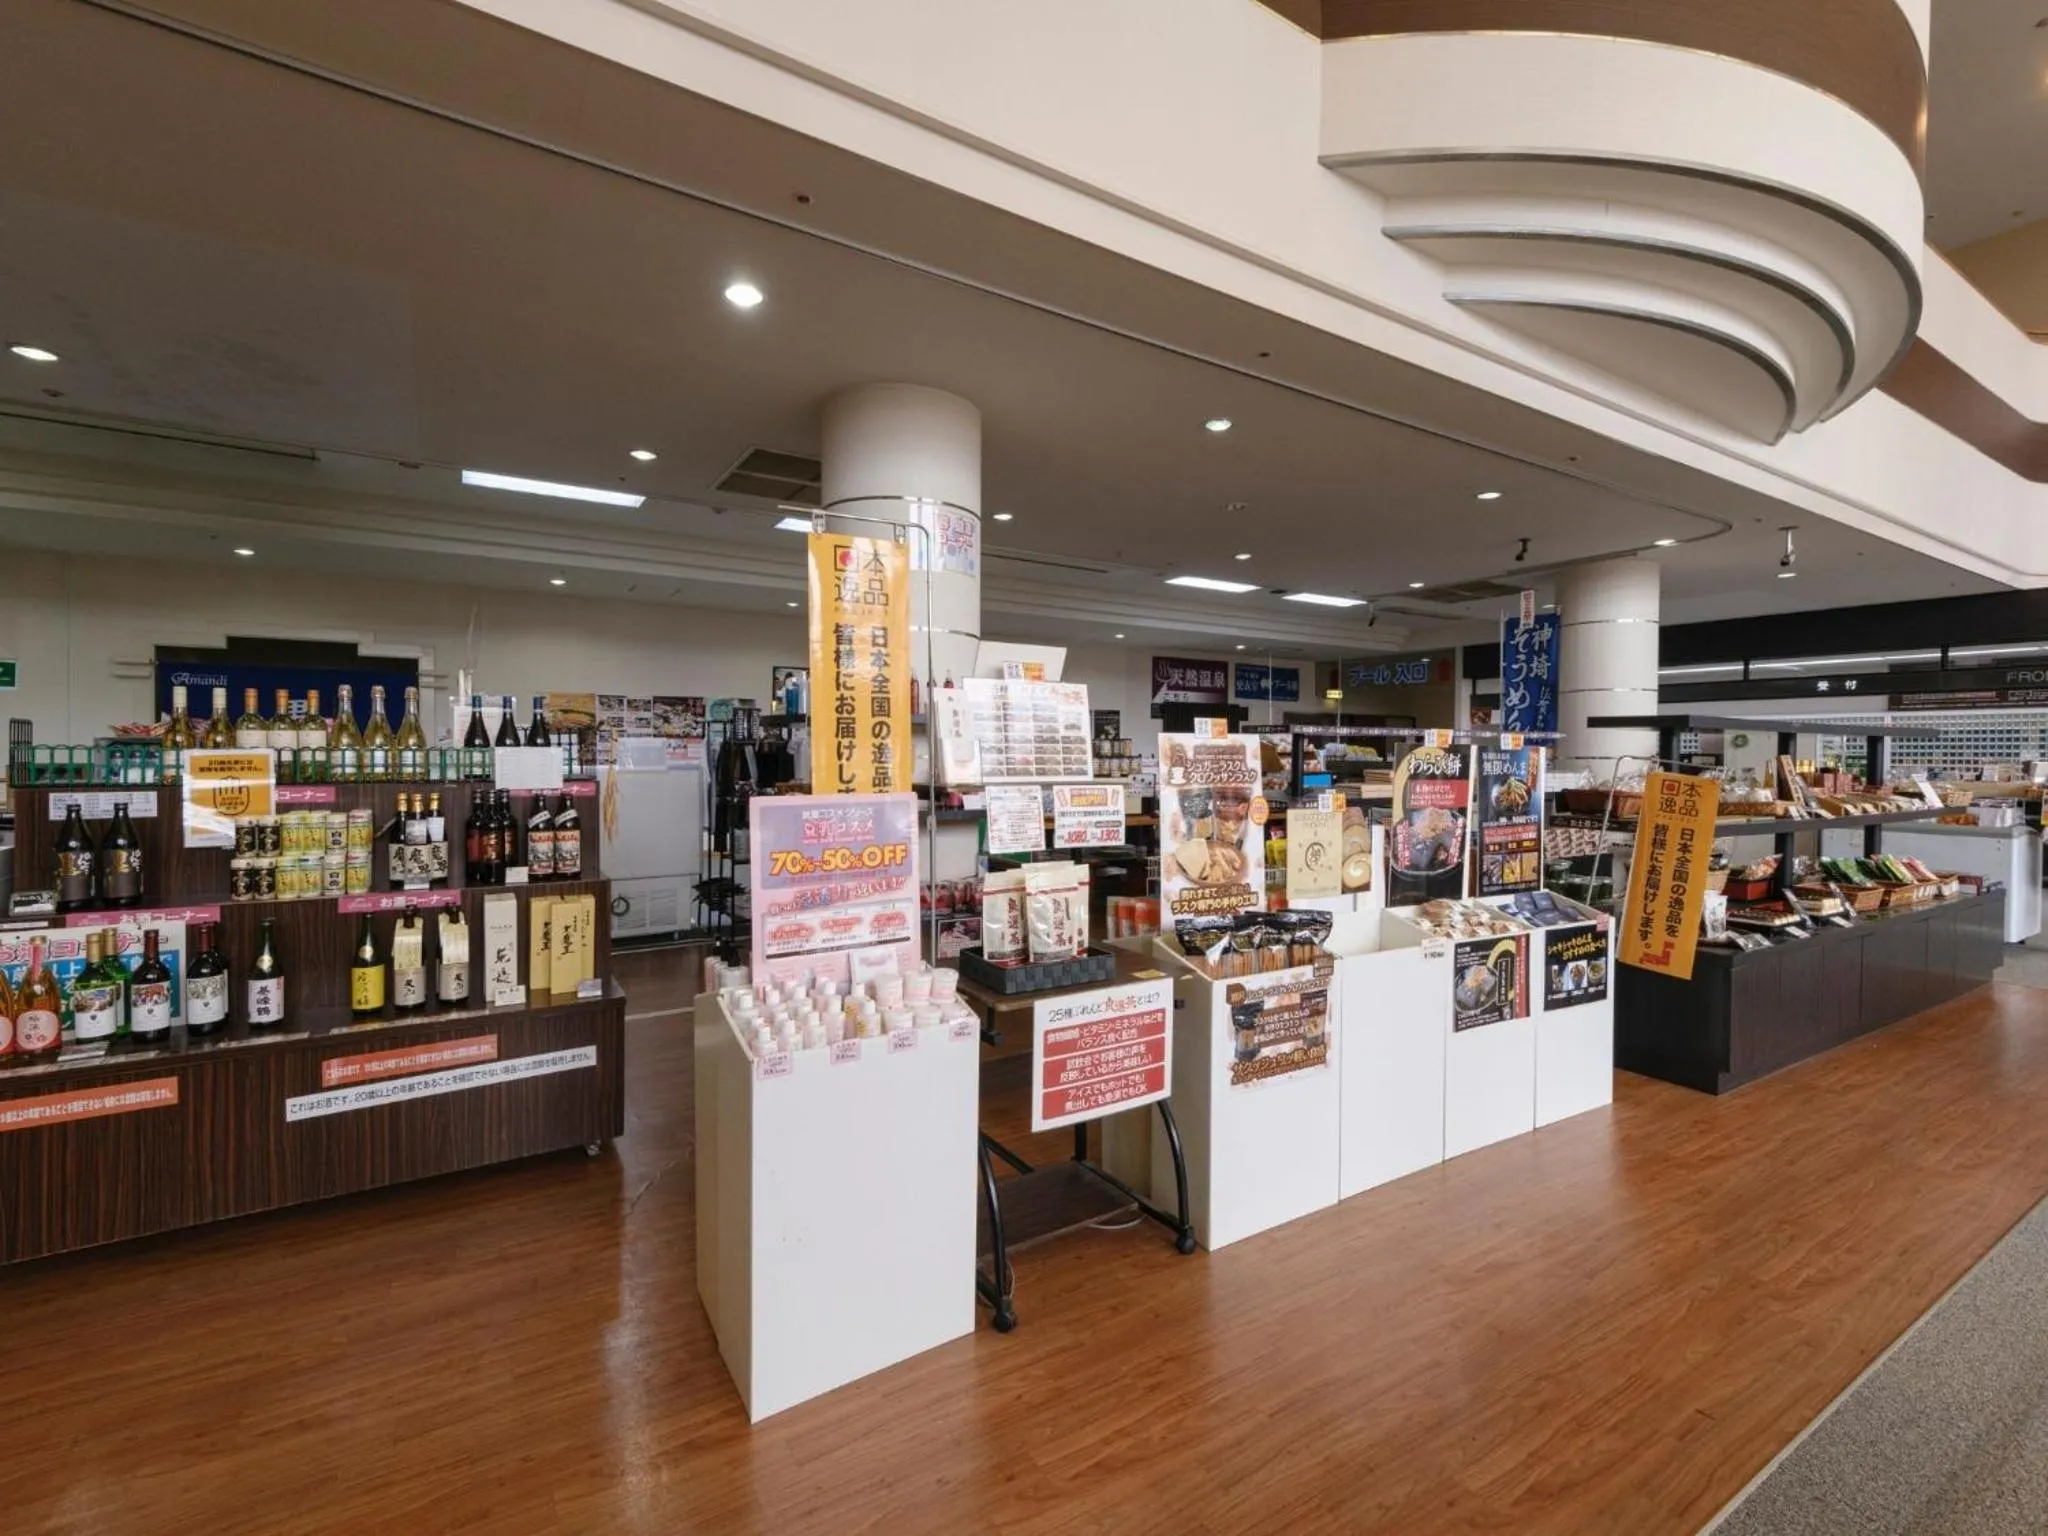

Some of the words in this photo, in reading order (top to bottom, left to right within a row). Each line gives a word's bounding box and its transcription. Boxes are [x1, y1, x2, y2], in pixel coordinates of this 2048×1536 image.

[835, 576, 889, 606] 逸品
[171, 672, 228, 687] Amandi
[1169, 668, 1225, 688] 天然温泉
[1349, 666, 1390, 686] プール
[1395, 662, 1428, 684] 入口
[2006, 670, 2048, 683] FRO
[1816, 680, 1858, 692] 受付
[833, 622, 857, 793] 皆様にお届けし
[870, 625, 892, 793] 日本全国の逸品
[1408, 752, 1462, 777] わらび餅
[1482, 760, 1528, 777] 無限めんま
[275, 789, 328, 800] コーナー
[1657, 796, 1699, 818] 逸品
[1637, 823, 1670, 949] 皆様にお届けします。
[1664, 827, 1696, 939] 日本全国の逸品を
[380, 894, 453, 909] お酒コーナー
